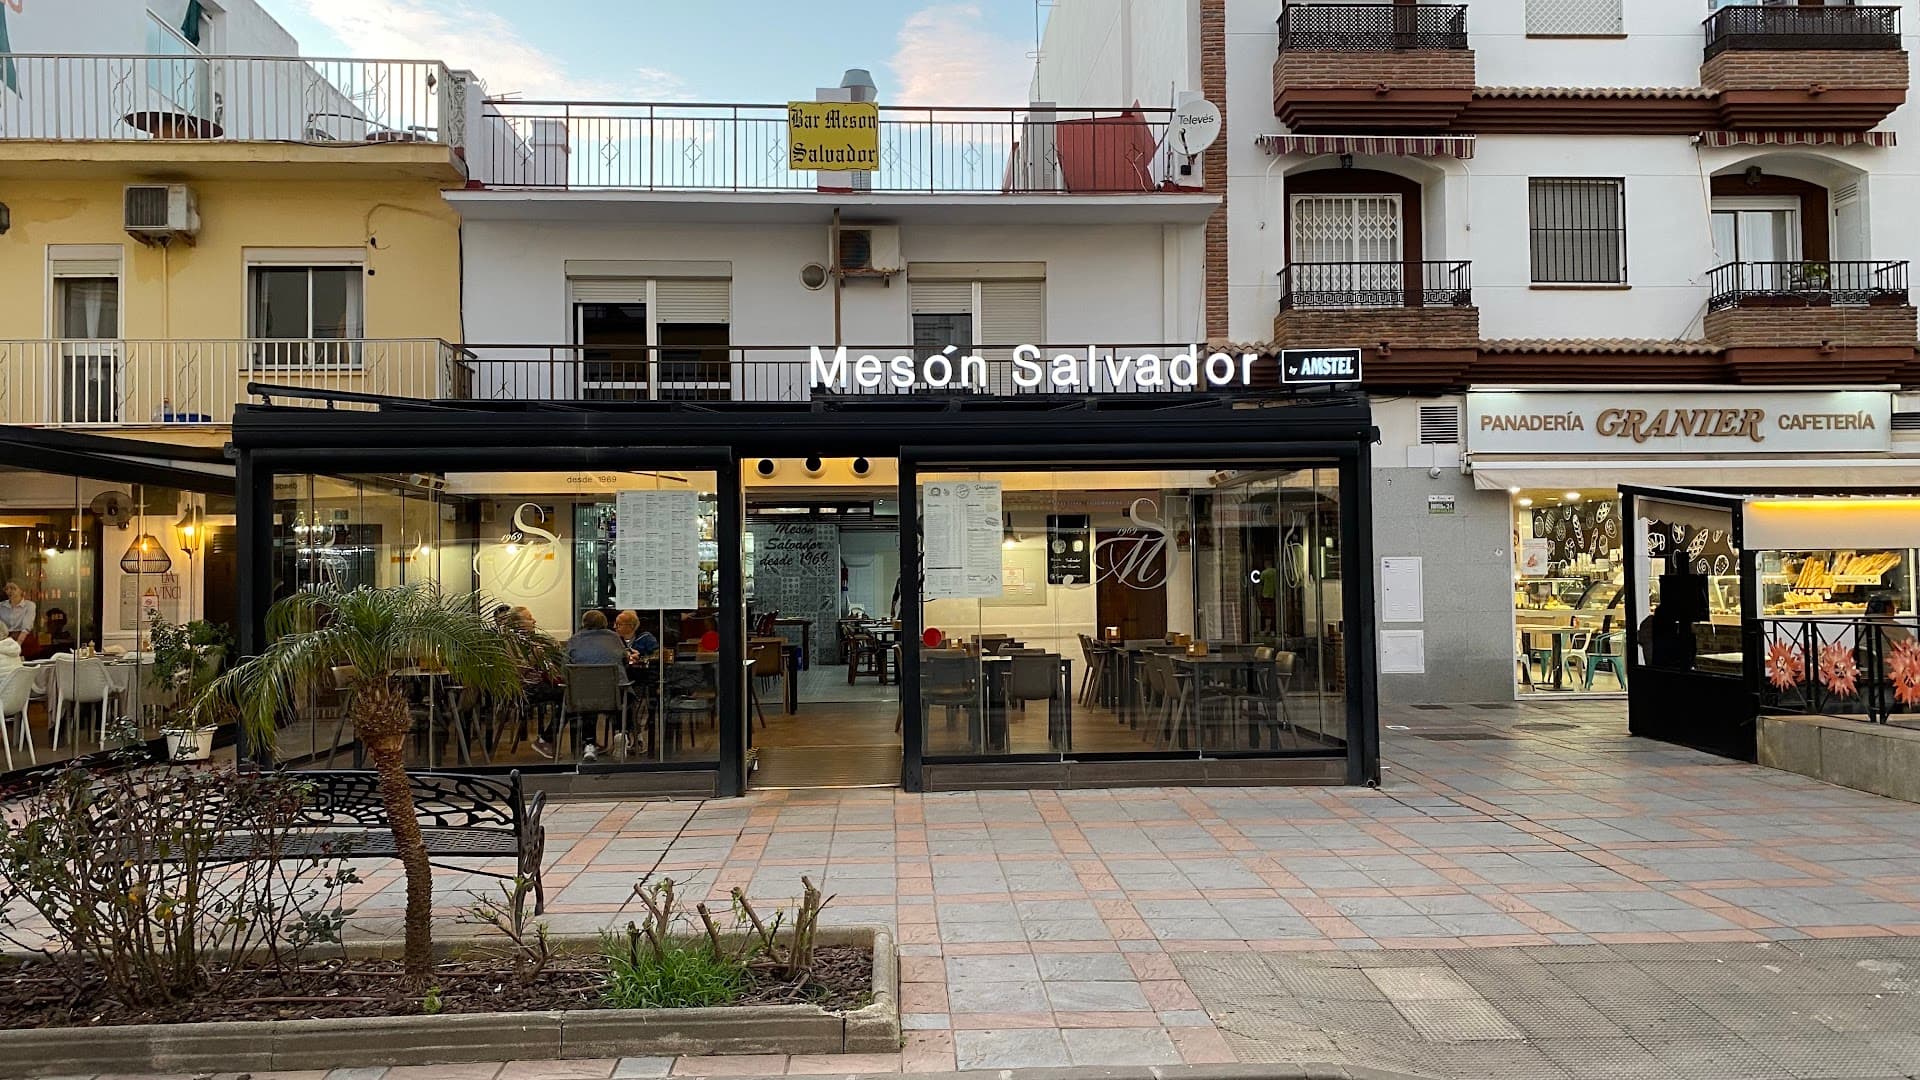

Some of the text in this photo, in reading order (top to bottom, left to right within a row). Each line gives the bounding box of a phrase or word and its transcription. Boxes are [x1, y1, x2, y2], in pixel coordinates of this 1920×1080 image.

[791, 108, 877, 129] Bar Meson
[792, 142, 876, 163] Salvador
[810, 343, 1258, 388] Mesón Salvador
[1288, 357, 1354, 375] by AMSTEL
[1480, 408, 1876, 443] PANADERÍA GRANIER CAFETERÍA
[566, 475, 617, 484] desde 1969
[500, 531, 523, 544] 1969
[760, 551, 829, 566] desde 1969
